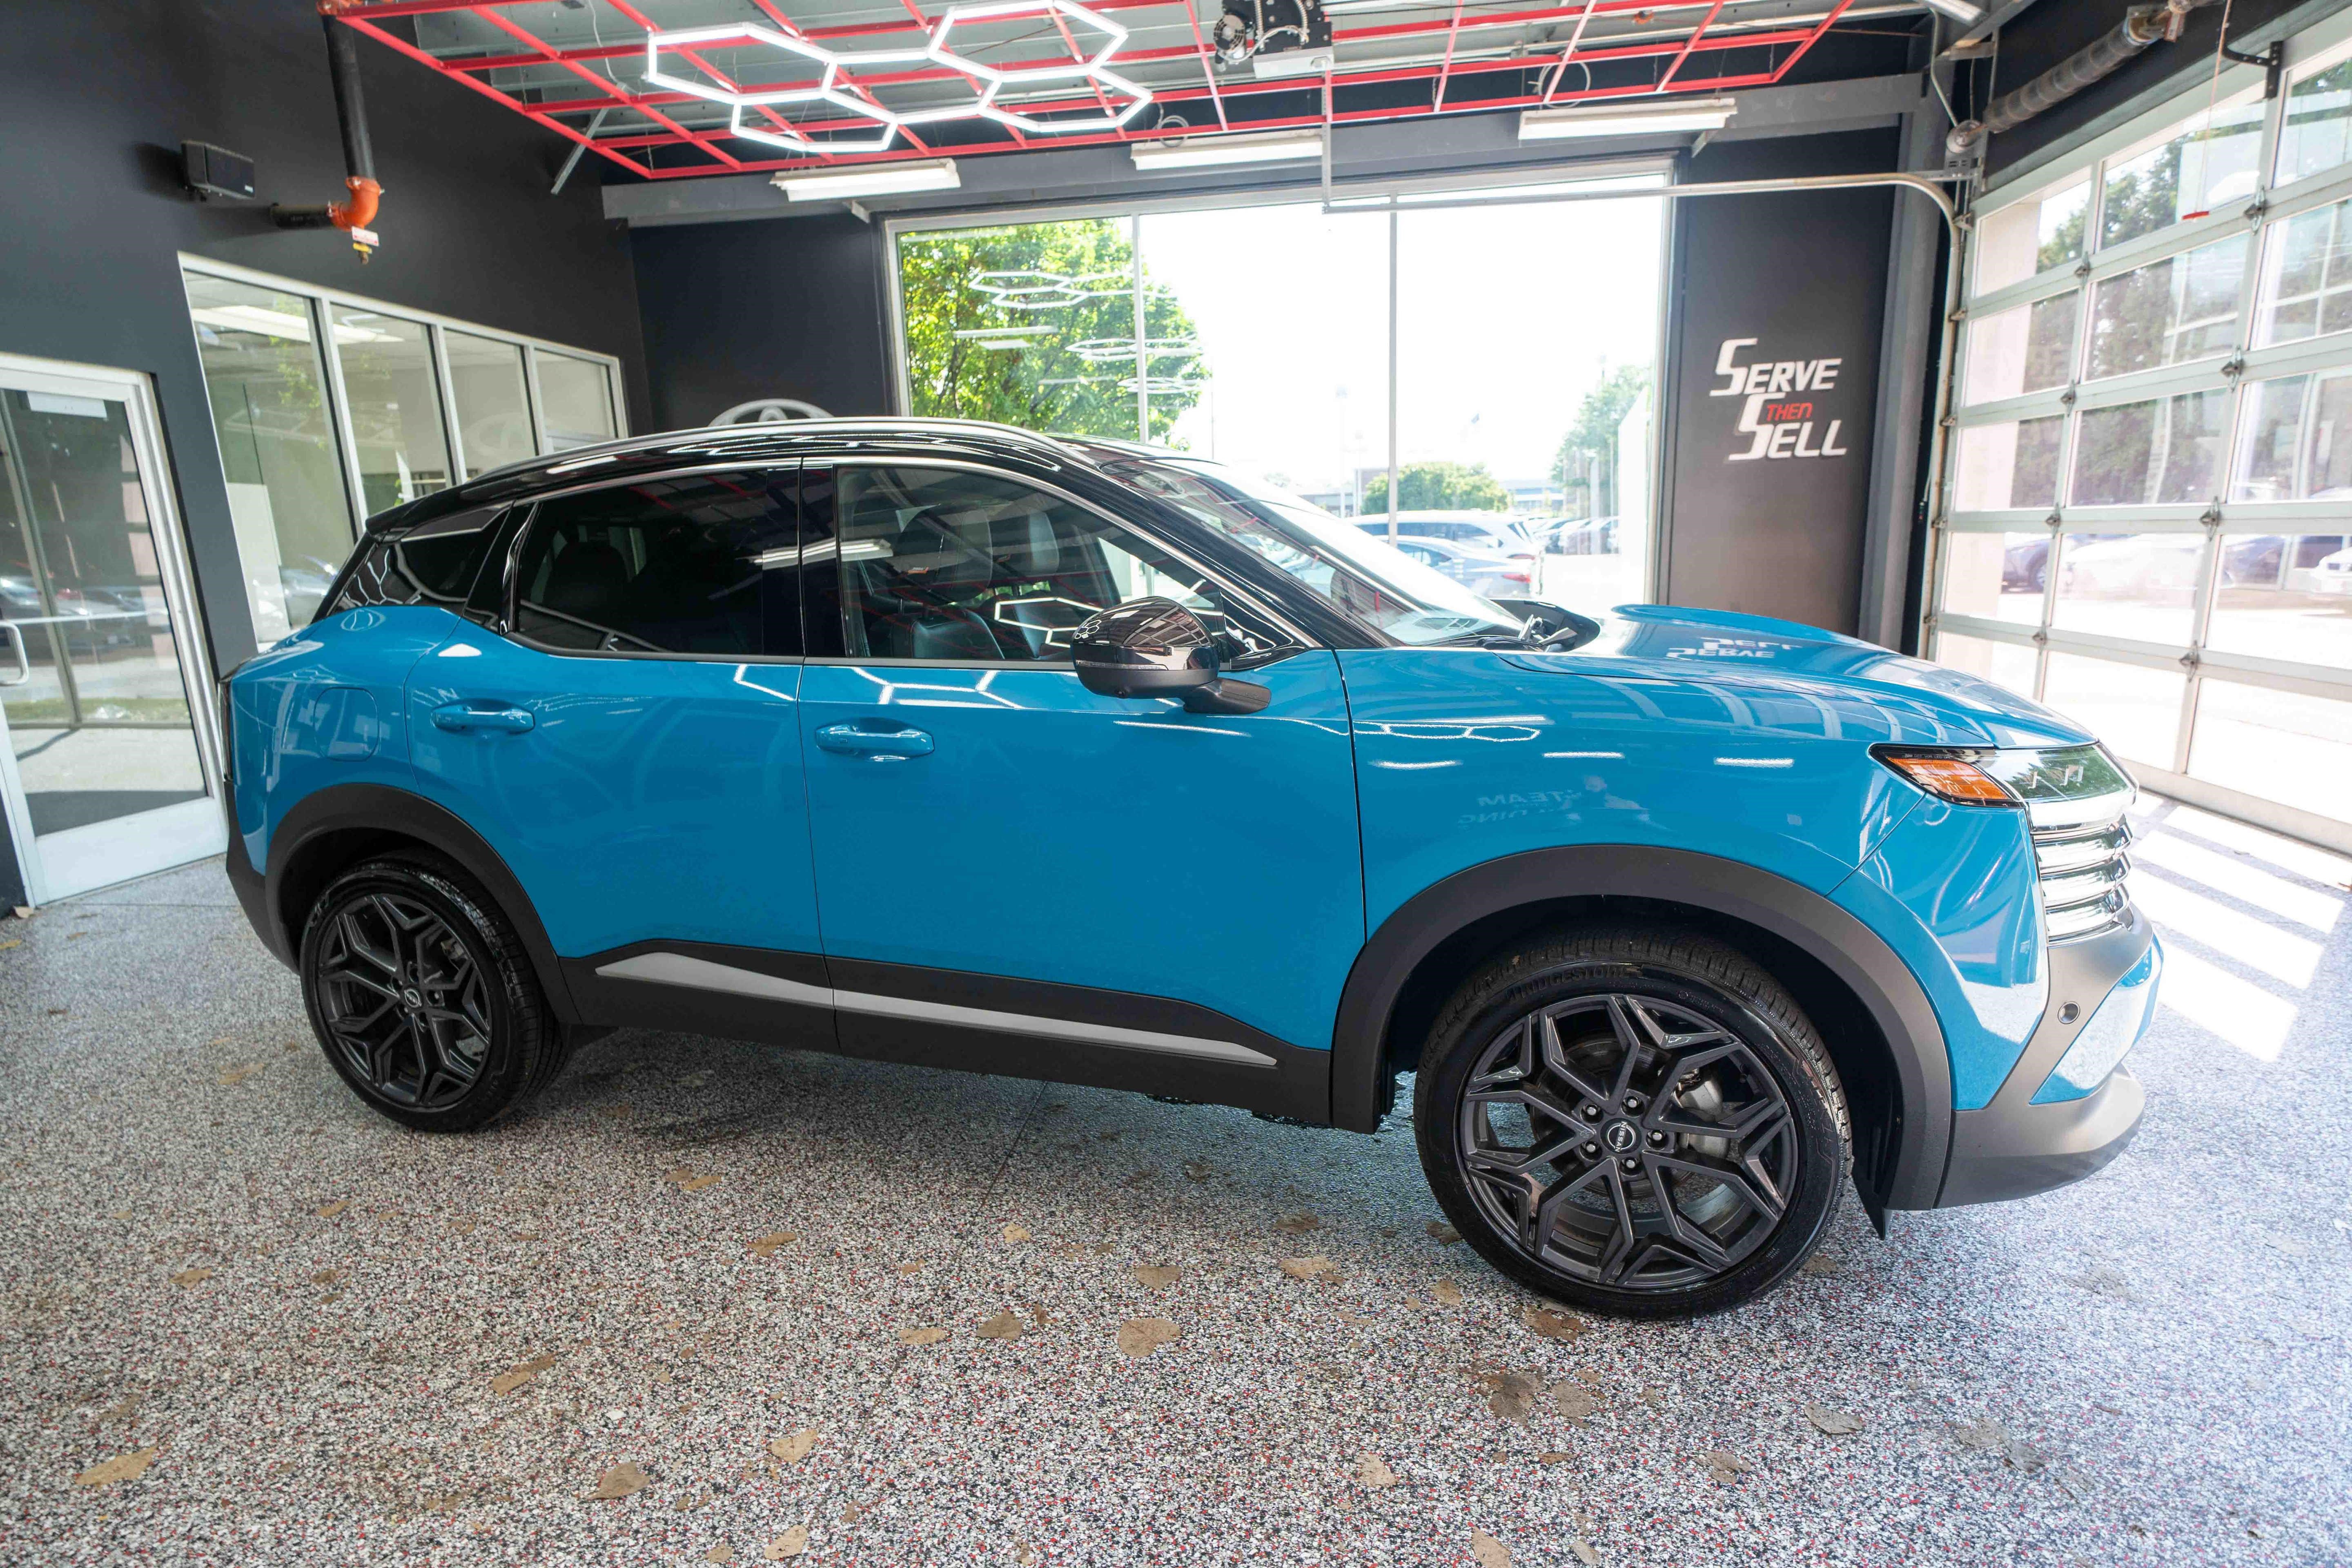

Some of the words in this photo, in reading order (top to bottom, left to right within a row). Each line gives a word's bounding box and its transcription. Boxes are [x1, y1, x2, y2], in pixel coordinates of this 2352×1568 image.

[1709, 338, 1842, 396] SERVE
[1728, 392, 1847, 461] SELL
[1766, 402, 1813, 421] THEN
[1615, 1120, 1628, 1152] NISSAN
